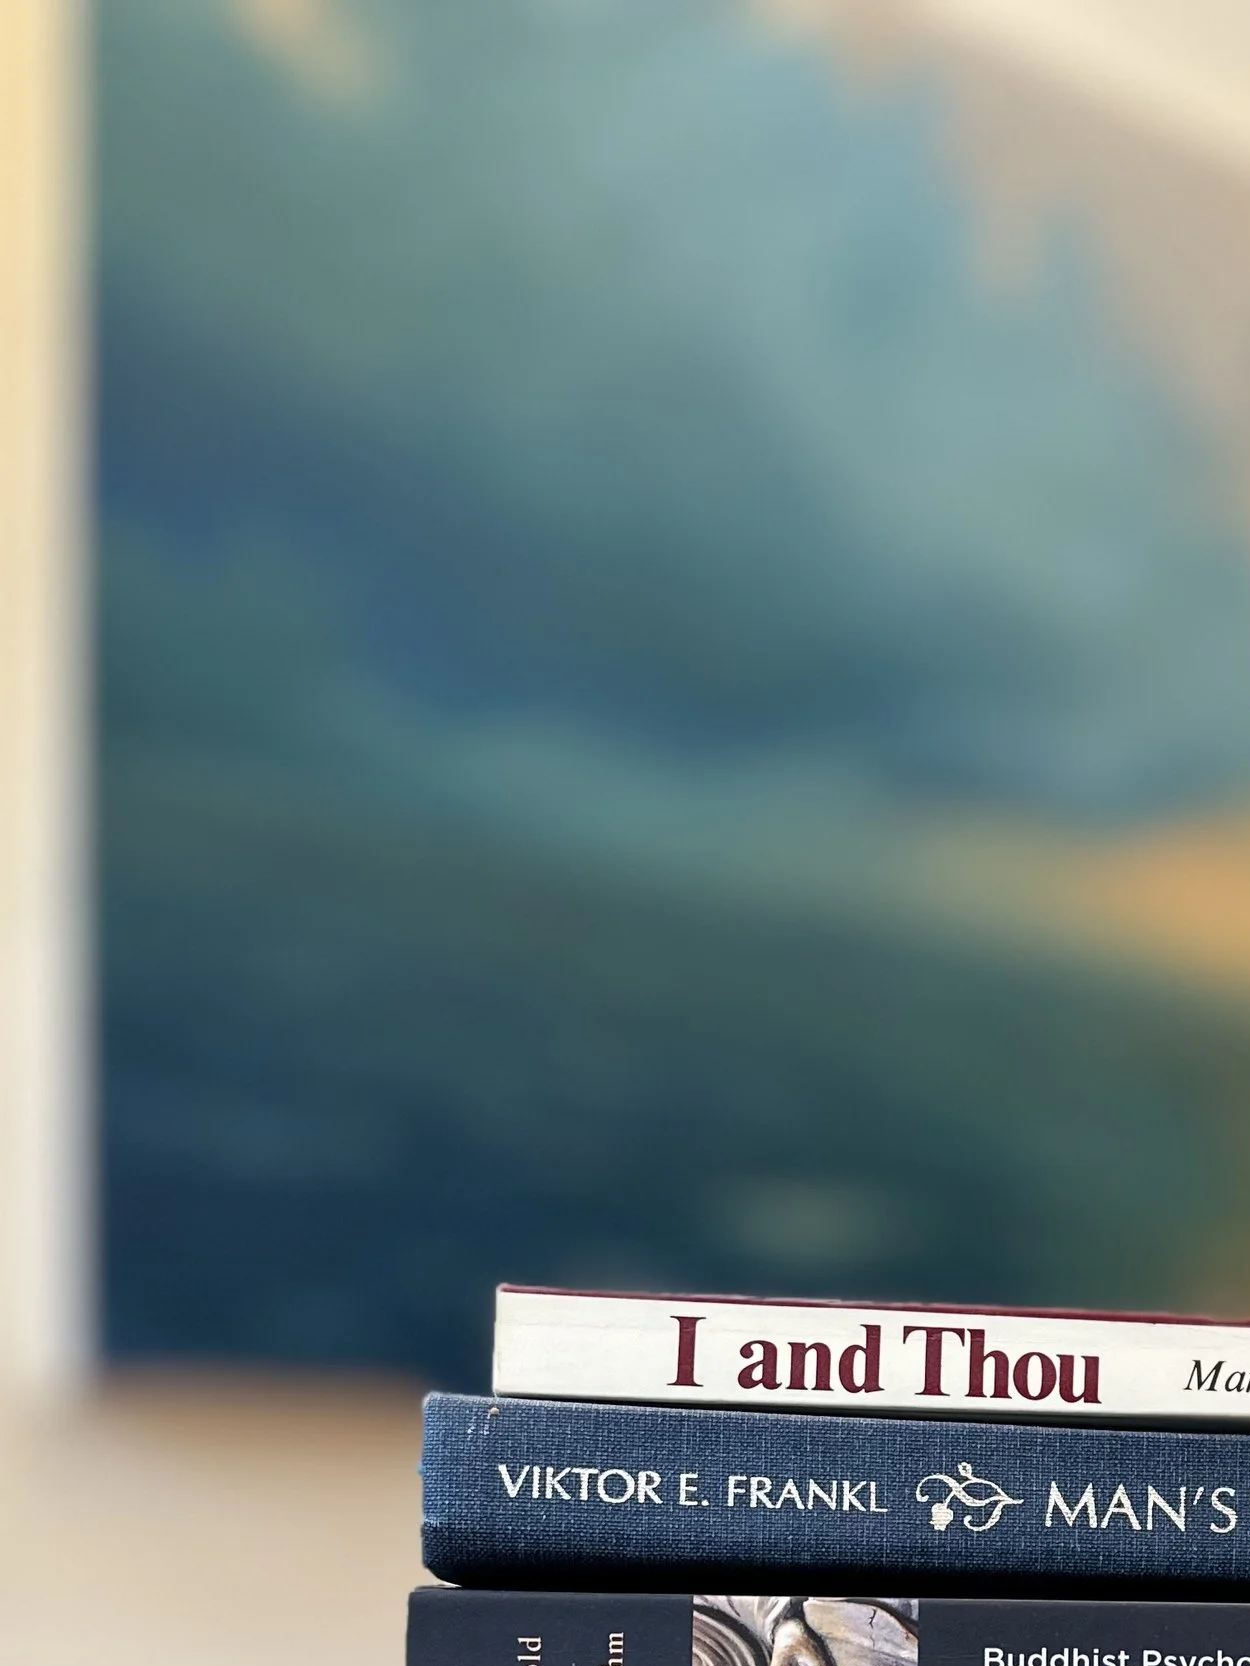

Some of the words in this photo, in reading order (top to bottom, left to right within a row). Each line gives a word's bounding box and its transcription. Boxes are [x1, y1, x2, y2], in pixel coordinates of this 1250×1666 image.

[667, 1316, 705, 1387] I
[737, 1324, 883, 1397] and
[903, 1325, 1102, 1404] Thou
[498, 1465, 662, 1505] VIKTOR
[679, 1474, 709, 1507] E.
[727, 1475, 888, 1514] FRANKL
[1045, 1479, 1238, 1534] MAN'S
